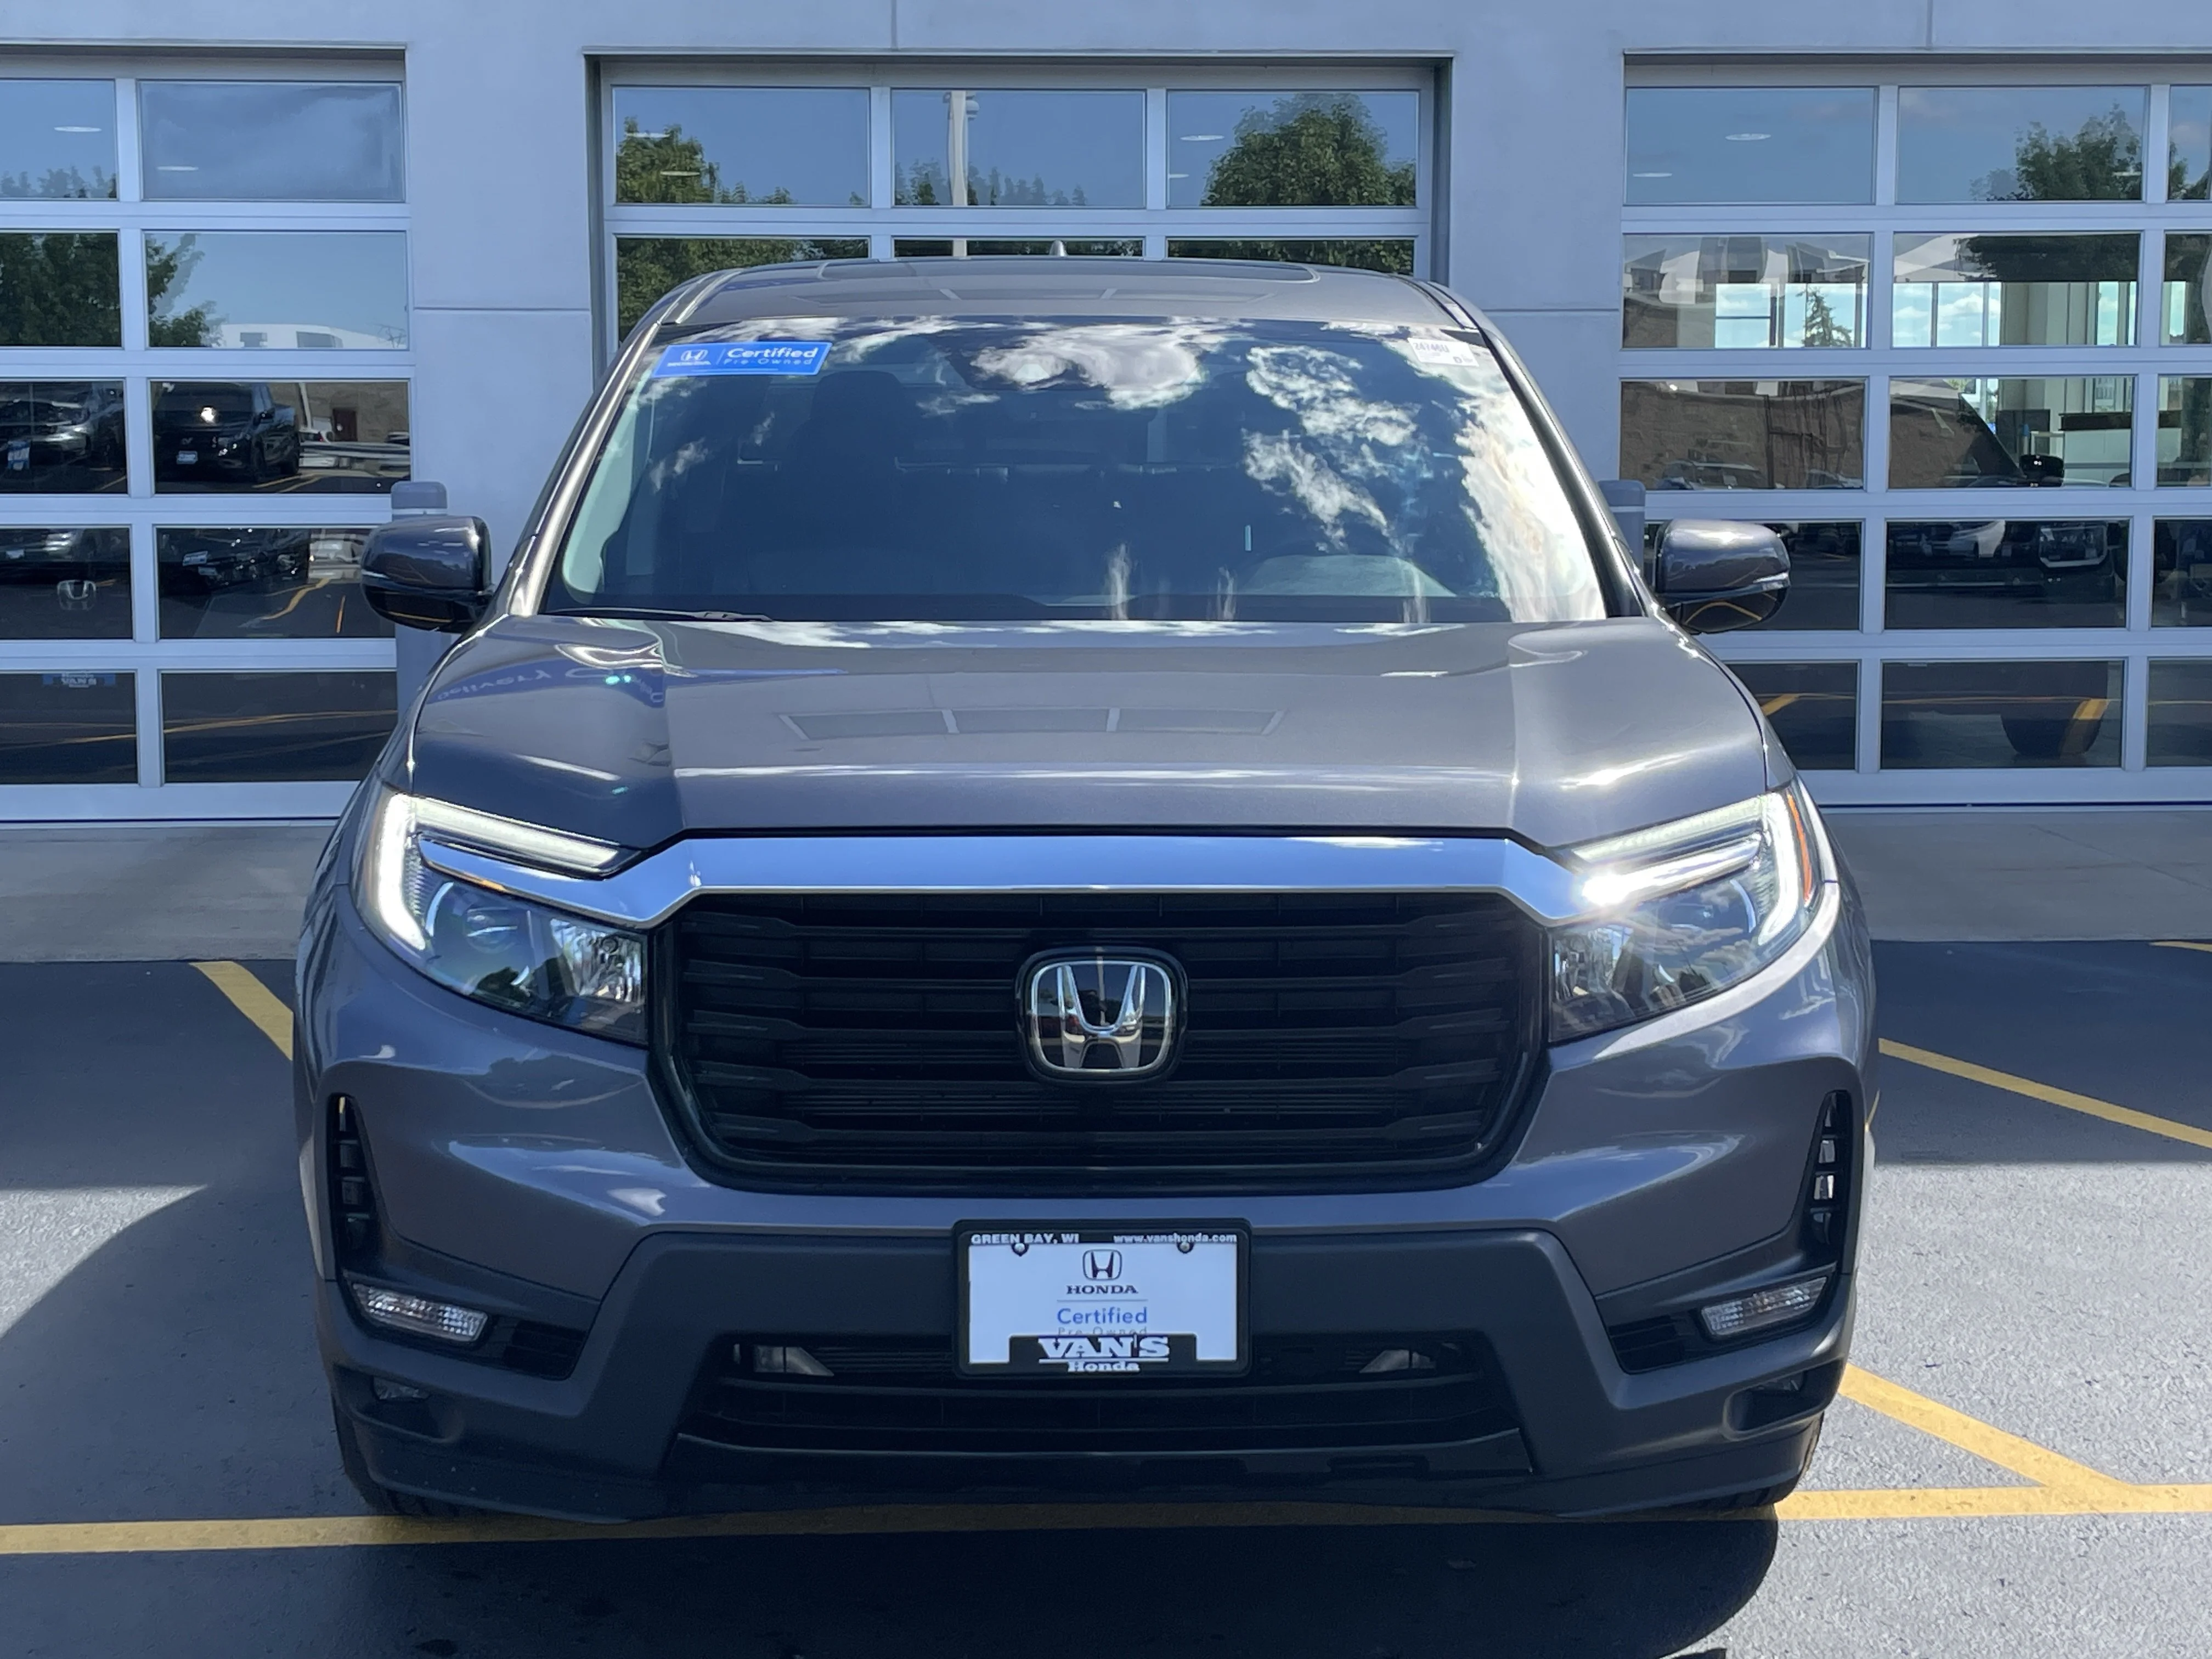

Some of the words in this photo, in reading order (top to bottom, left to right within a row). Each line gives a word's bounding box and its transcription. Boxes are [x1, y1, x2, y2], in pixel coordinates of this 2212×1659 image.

[727, 347, 819, 358] Certified
[971, 1234, 1020, 1244] GREEN
[1024, 1233, 1058, 1244] BAY,
[1061, 1233, 1080, 1243] WI
[1113, 1233, 1237, 1243] www.vanshonda.com
[1066, 1285, 1138, 1294] HONDA
[1057, 1306, 1147, 1324] Certified
[1038, 1334, 1170, 1358] VAN'S
[1068, 1361, 1140, 1372] Honda
